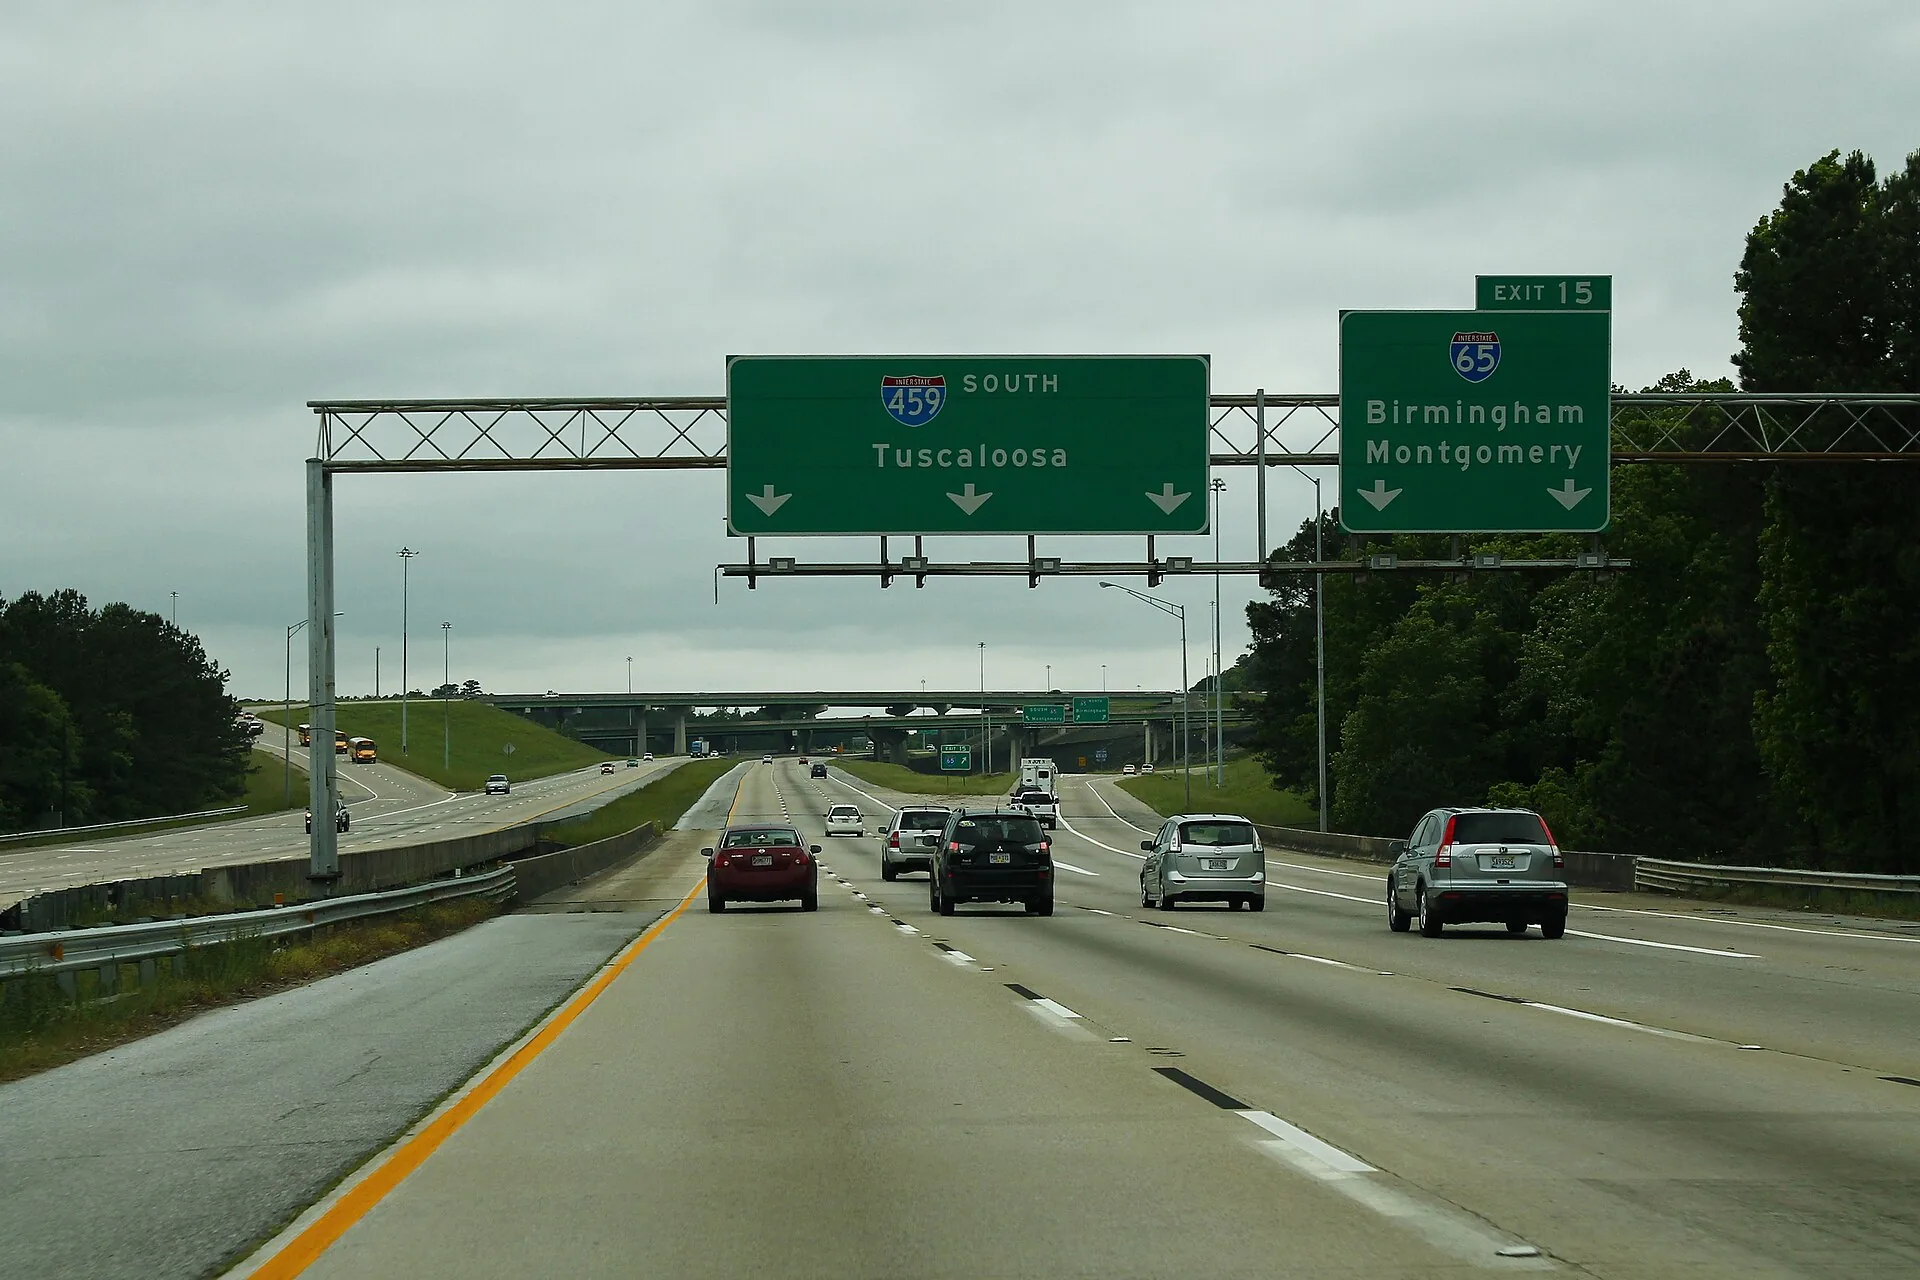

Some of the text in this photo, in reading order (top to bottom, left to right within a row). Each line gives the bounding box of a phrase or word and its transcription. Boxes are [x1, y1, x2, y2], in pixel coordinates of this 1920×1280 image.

[1494, 281, 1593, 305] EXIT 15
[1457, 334, 1493, 342] INTERSTATE
[1456, 345, 1495, 372] 65
[963, 374, 1058, 393] SOUTH
[888, 388, 940, 415] 459
[1366, 399, 1585, 432] Birmingham
[872, 443, 1067, 467] Tuscaloosa
[1366, 439, 1583, 472] Montgomery
